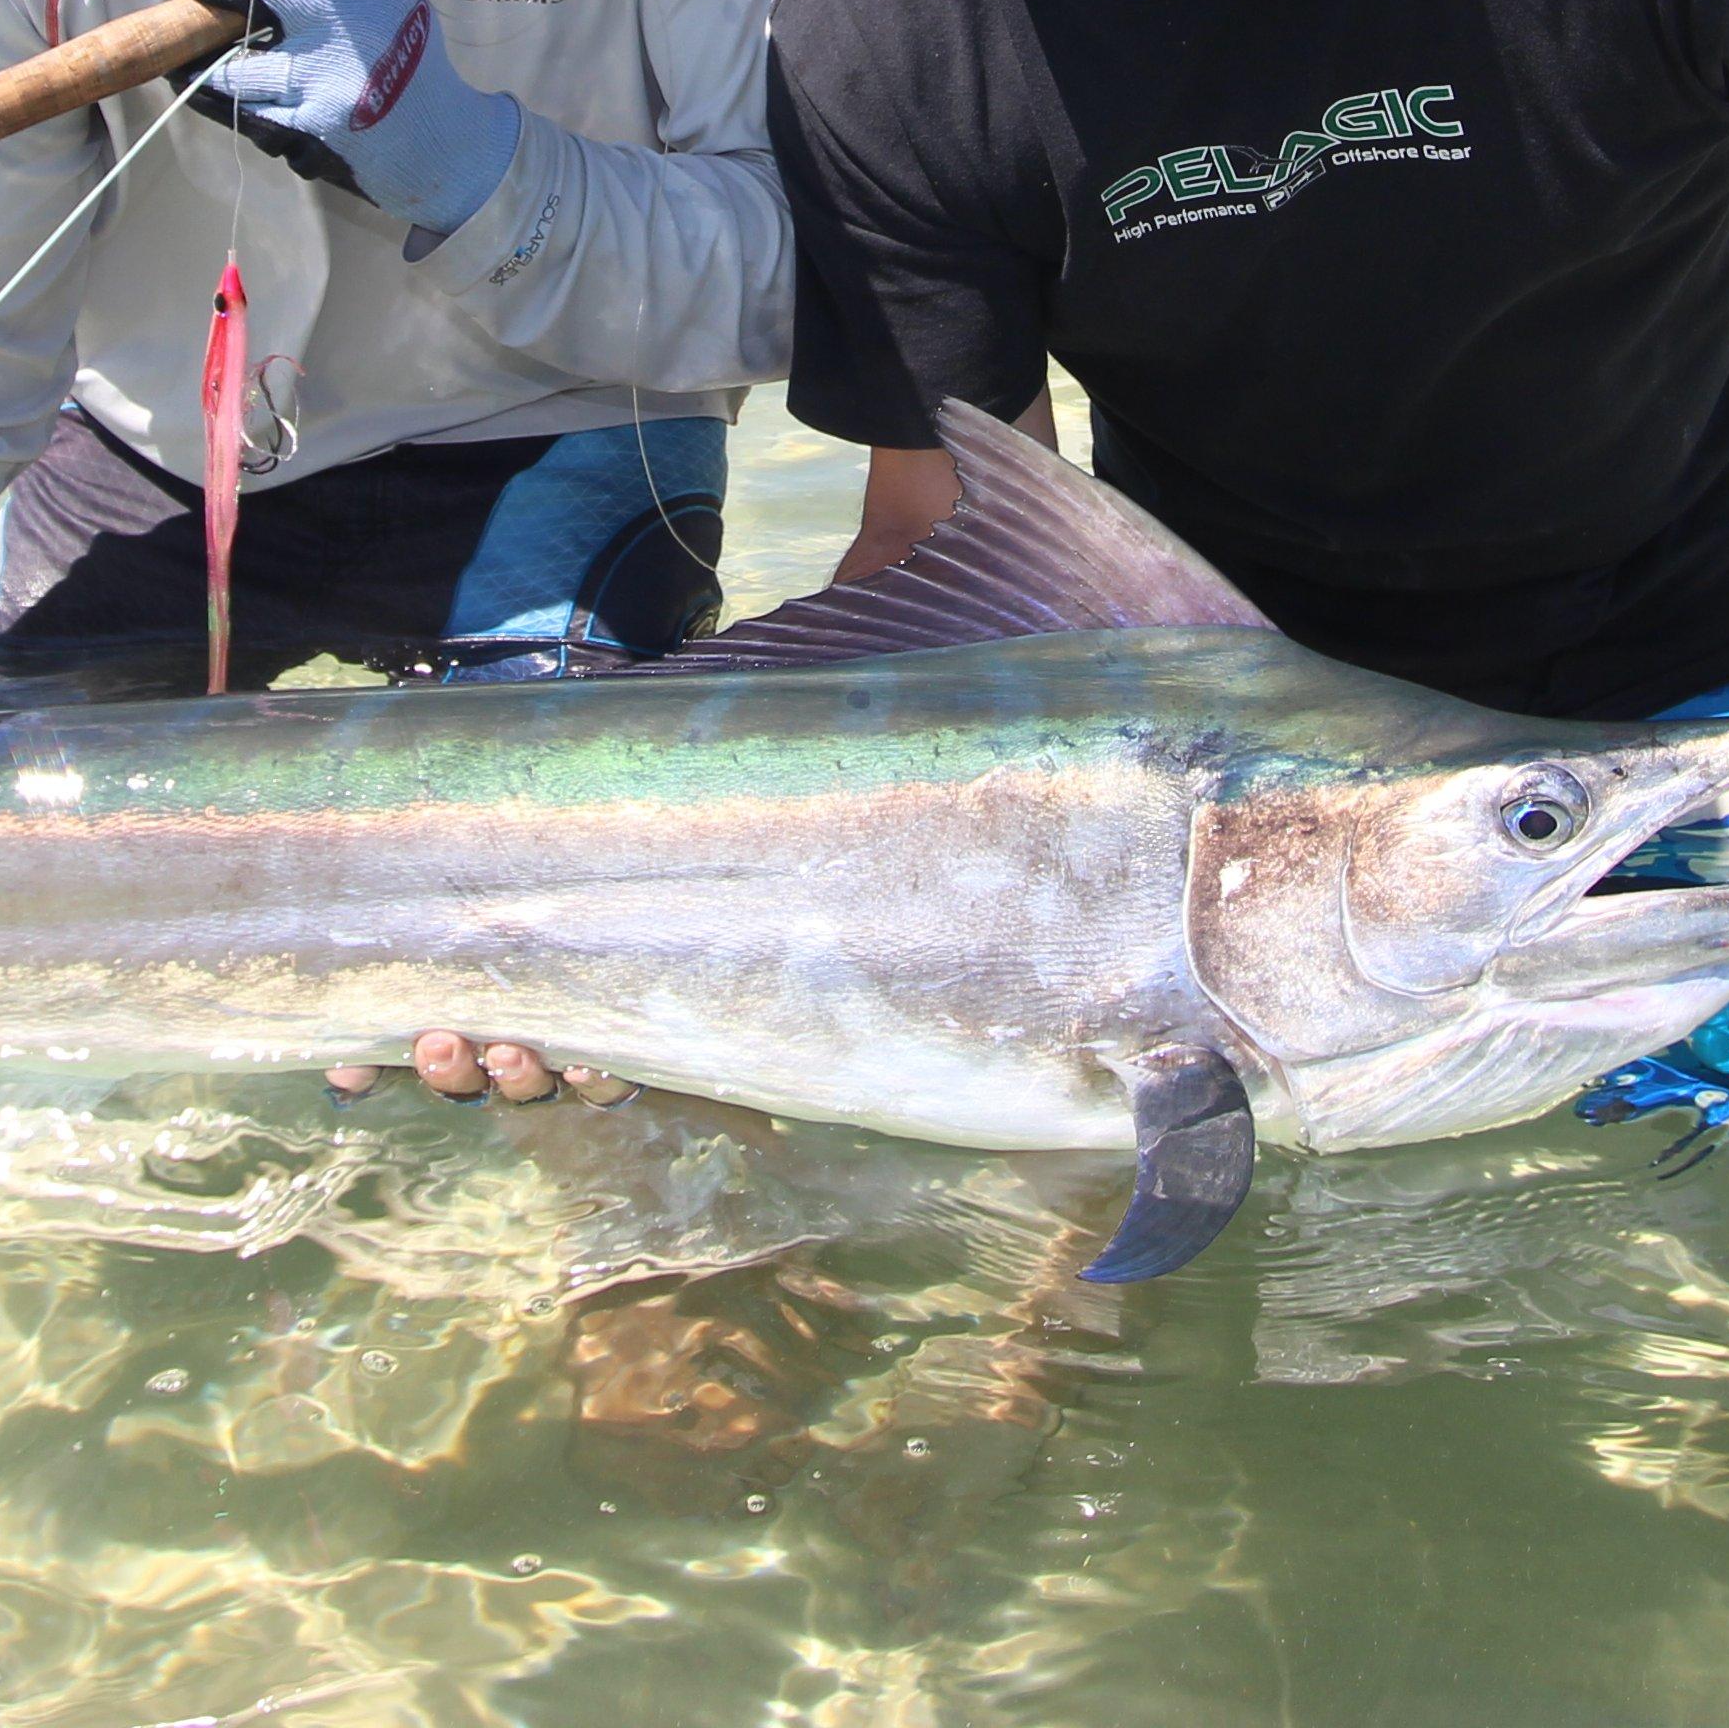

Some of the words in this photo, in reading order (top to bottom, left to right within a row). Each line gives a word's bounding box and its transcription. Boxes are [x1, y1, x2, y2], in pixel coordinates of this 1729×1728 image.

[1101, 84, 1464, 226] PELAGIC
[1331, 143, 1420, 167] Offshore
[1424, 144, 1473, 162] Gear
[1114, 220, 1153, 245] High
[1154, 202, 1257, 230] Performance
